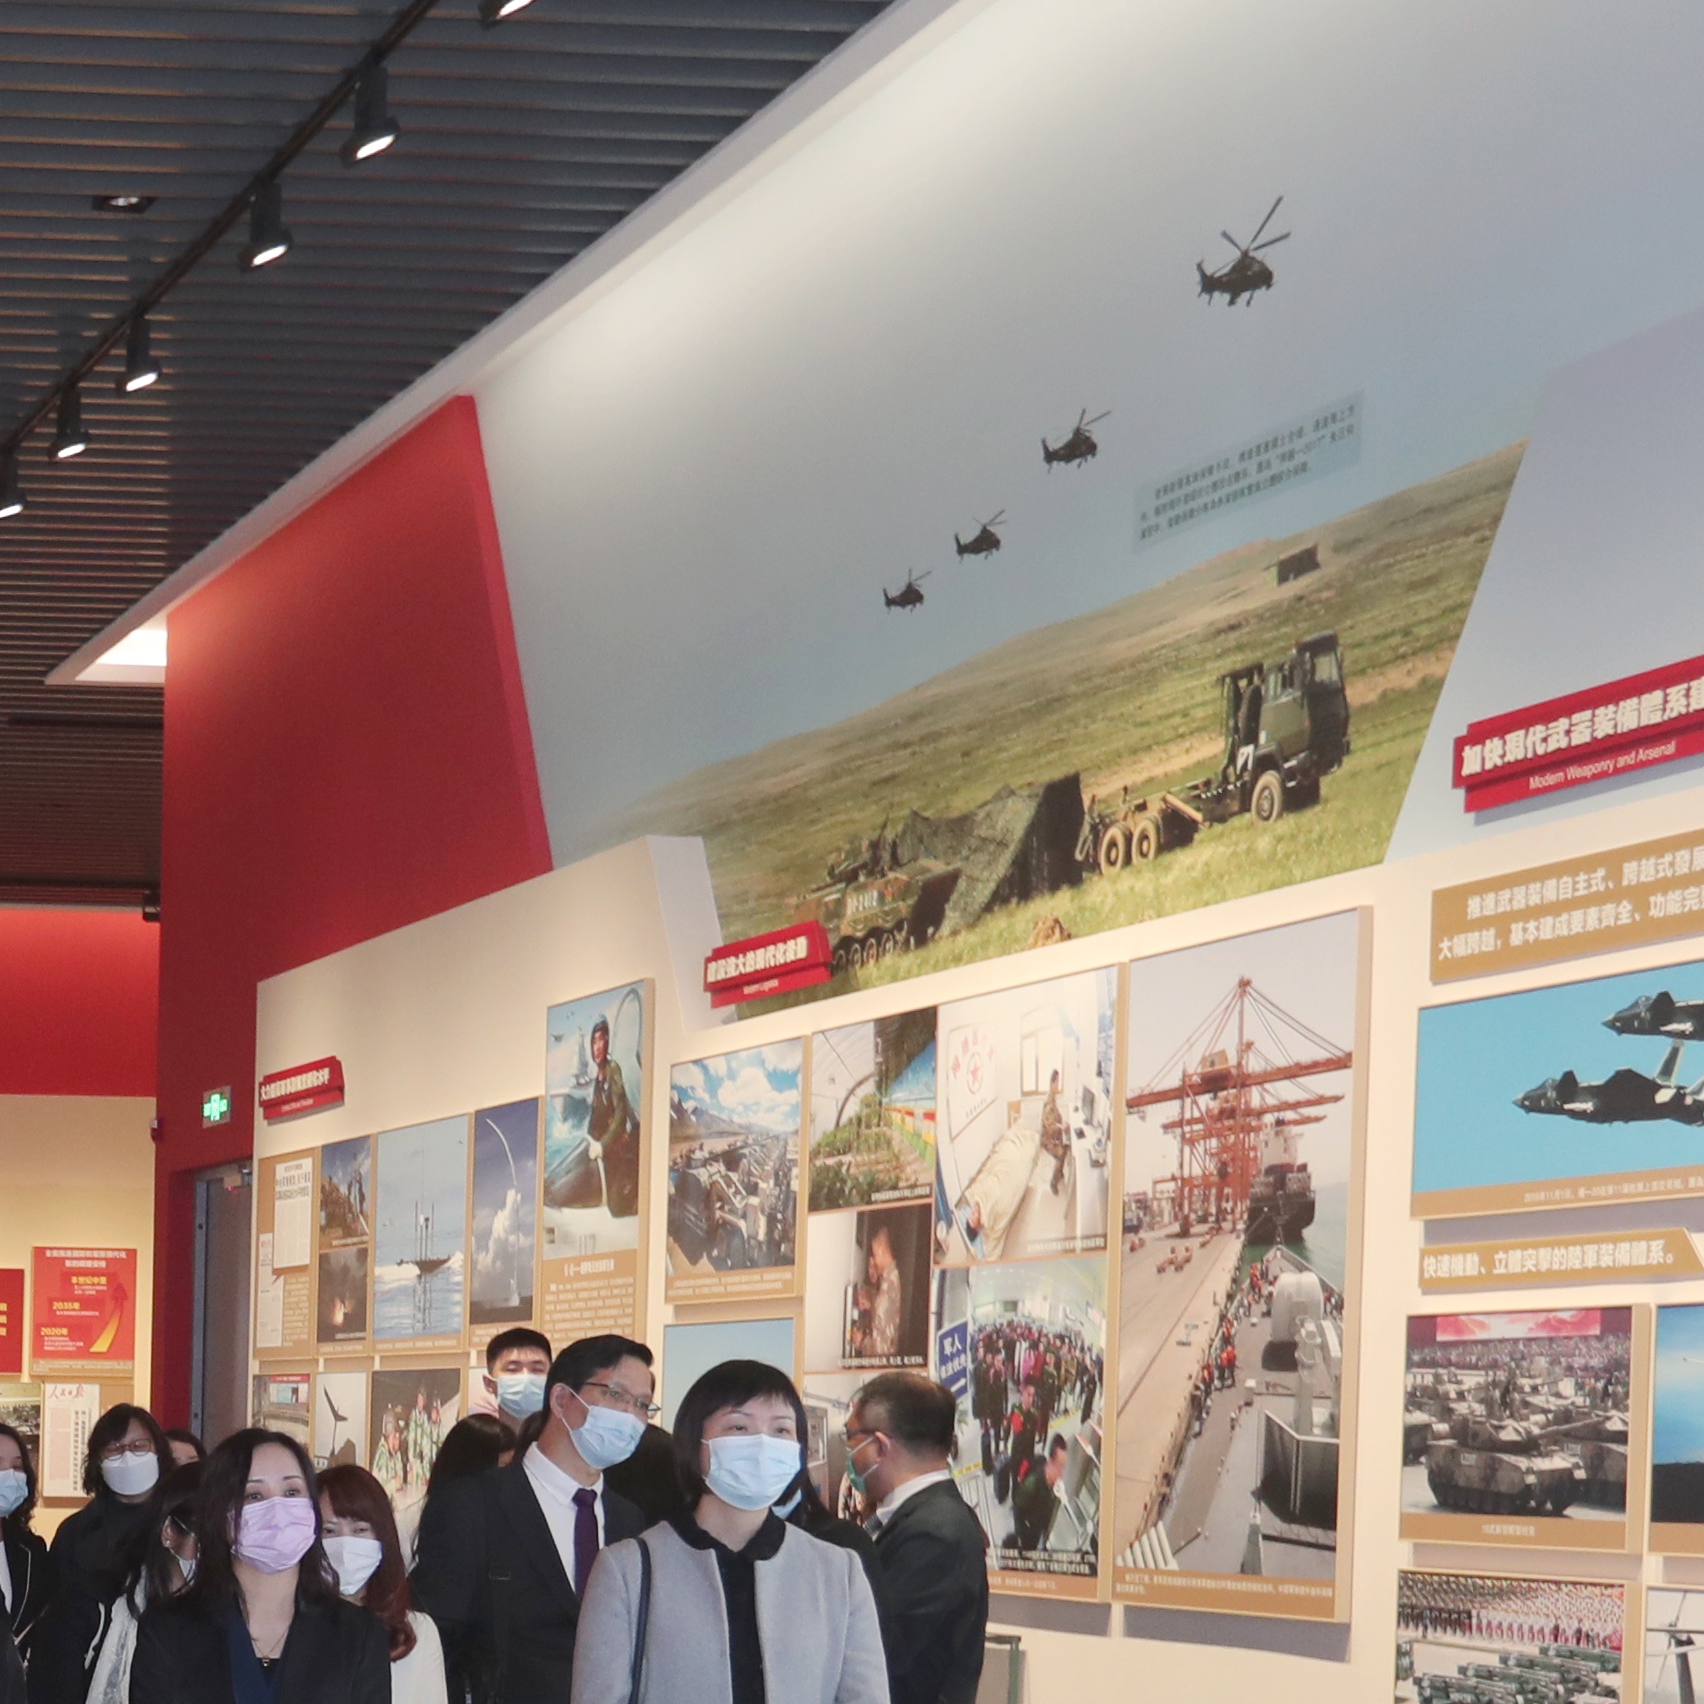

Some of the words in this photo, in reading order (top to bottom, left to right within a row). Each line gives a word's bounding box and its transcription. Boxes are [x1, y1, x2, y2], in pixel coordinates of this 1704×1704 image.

[1529, 769, 1564, 790] Modern
[1566, 758, 1615, 781] Weaponry
[1616, 750, 1636, 768] and
[1636, 741, 1677, 762] Arsenal
